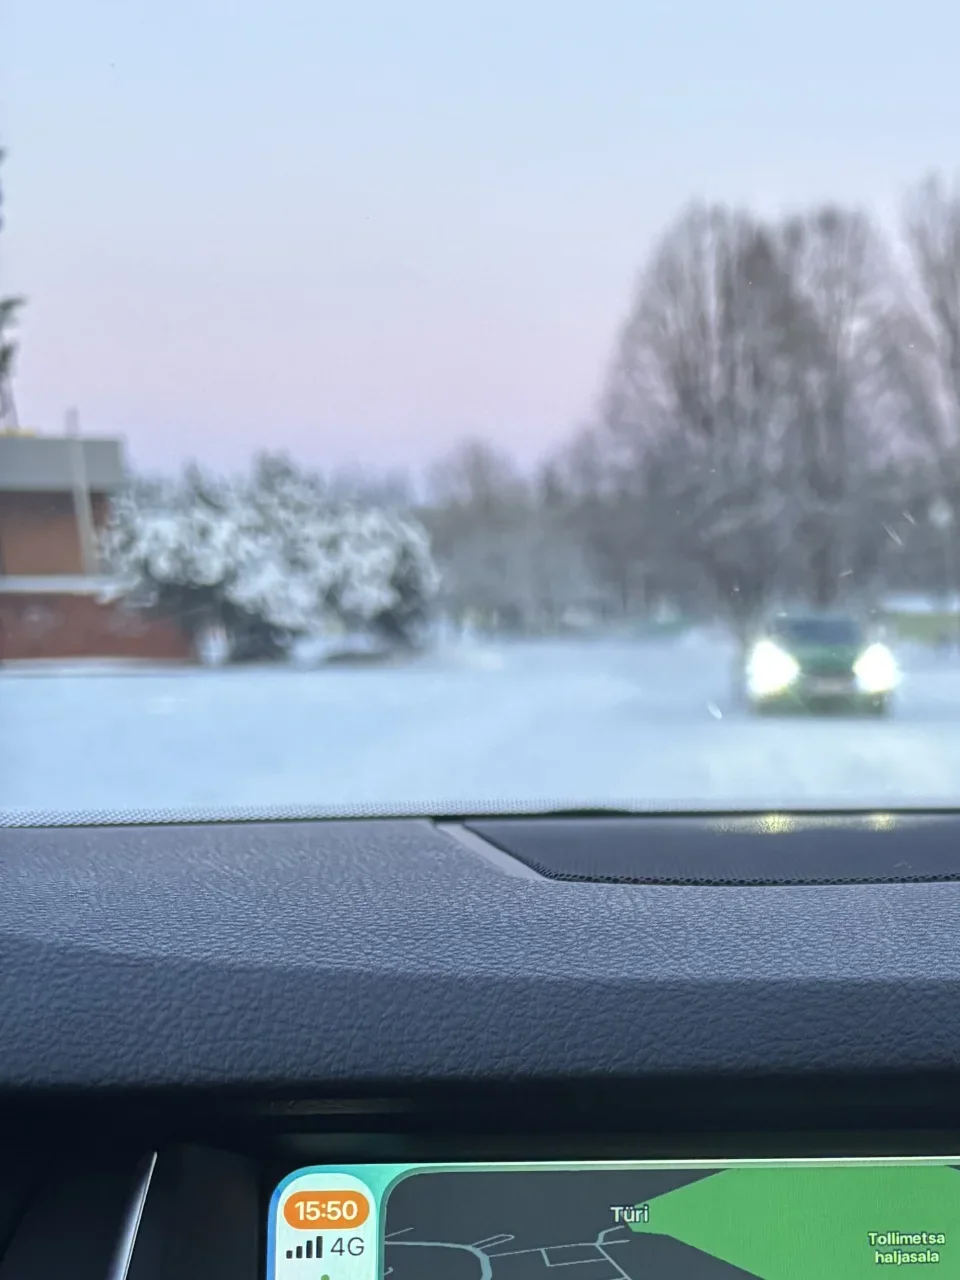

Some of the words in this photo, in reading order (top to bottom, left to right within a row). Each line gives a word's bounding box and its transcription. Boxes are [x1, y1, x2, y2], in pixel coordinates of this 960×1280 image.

[294, 1199, 358, 1221] 15:50
[610, 1205, 649, 1223] Türi
[330, 1236, 365, 1256] 4G
[868, 1232, 946, 1245] Tollimetsa
[874, 1249, 940, 1266] haljasala
